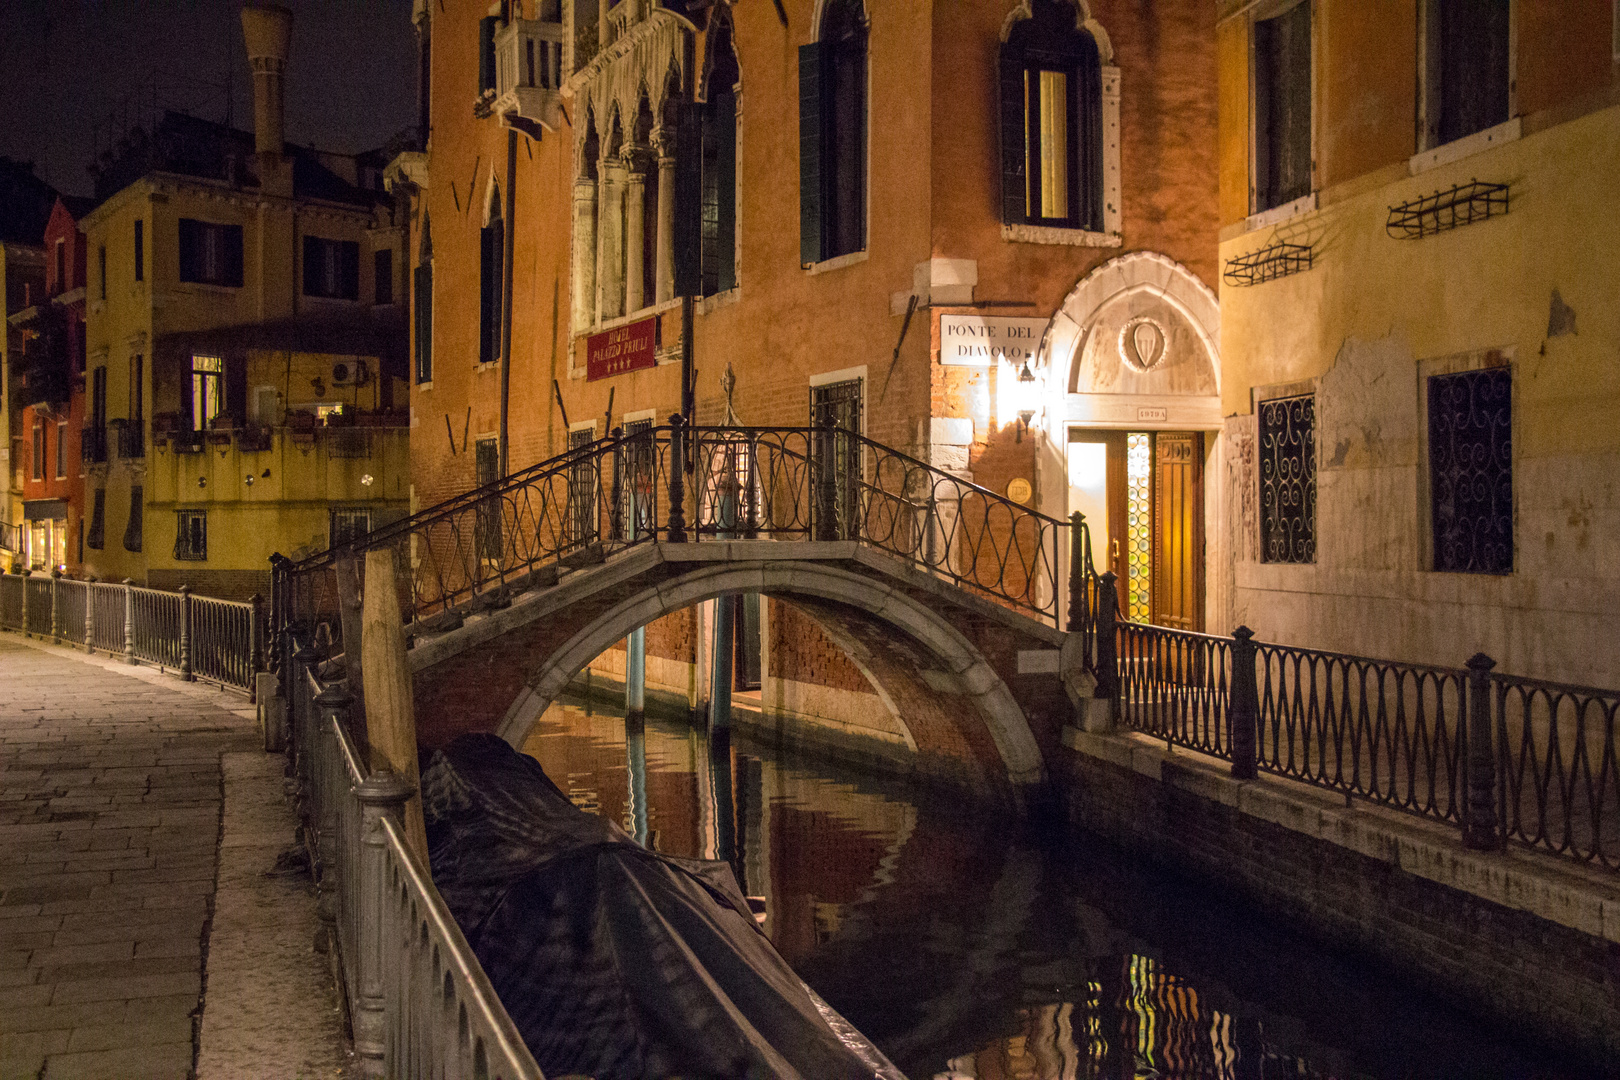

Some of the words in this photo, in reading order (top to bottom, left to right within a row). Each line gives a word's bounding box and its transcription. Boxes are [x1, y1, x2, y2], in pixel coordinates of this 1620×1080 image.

[608, 327, 630, 345] HOTEL
[947, 324, 996, 337] PONTE
[1007, 326, 1036, 339] DEL
[592, 343, 621, 363] PALAZZO
[623, 336, 648, 355] PRIULI
[958, 344, 1021, 358] DIAVOLO
